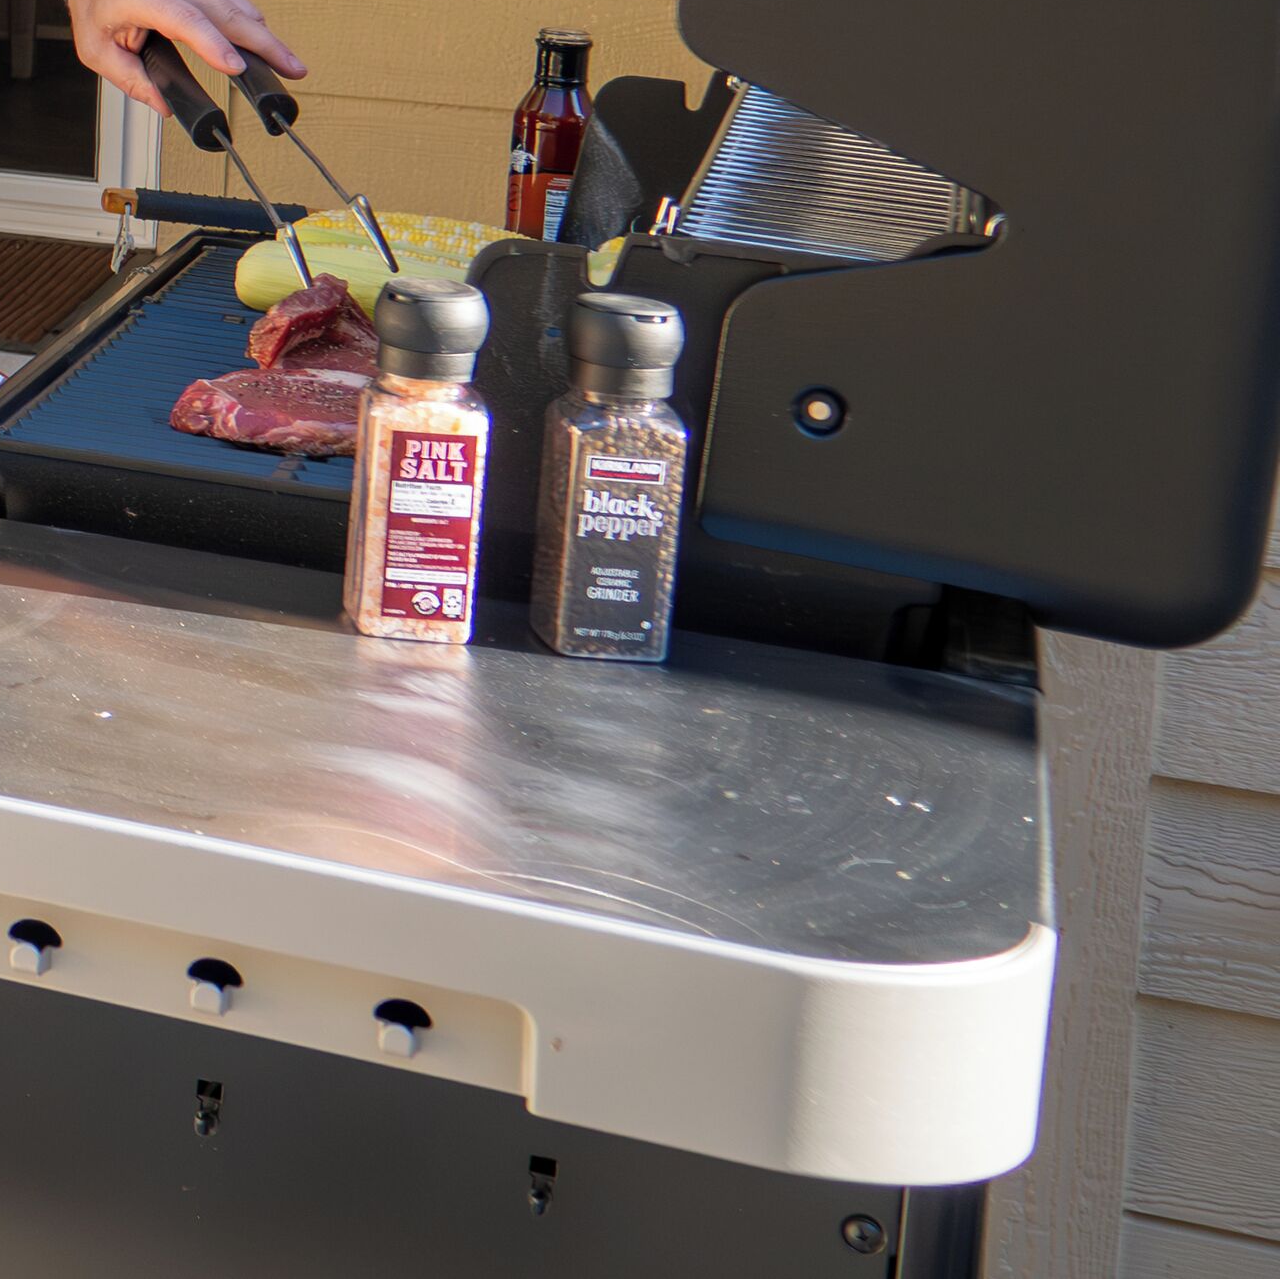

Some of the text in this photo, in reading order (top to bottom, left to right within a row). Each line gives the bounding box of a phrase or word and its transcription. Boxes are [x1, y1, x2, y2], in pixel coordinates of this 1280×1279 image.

[405, 439, 466, 461] PINK
[400, 458, 468, 482] SALT
[583, 489, 663, 521] black
[576, 514, 664, 541] pepper
